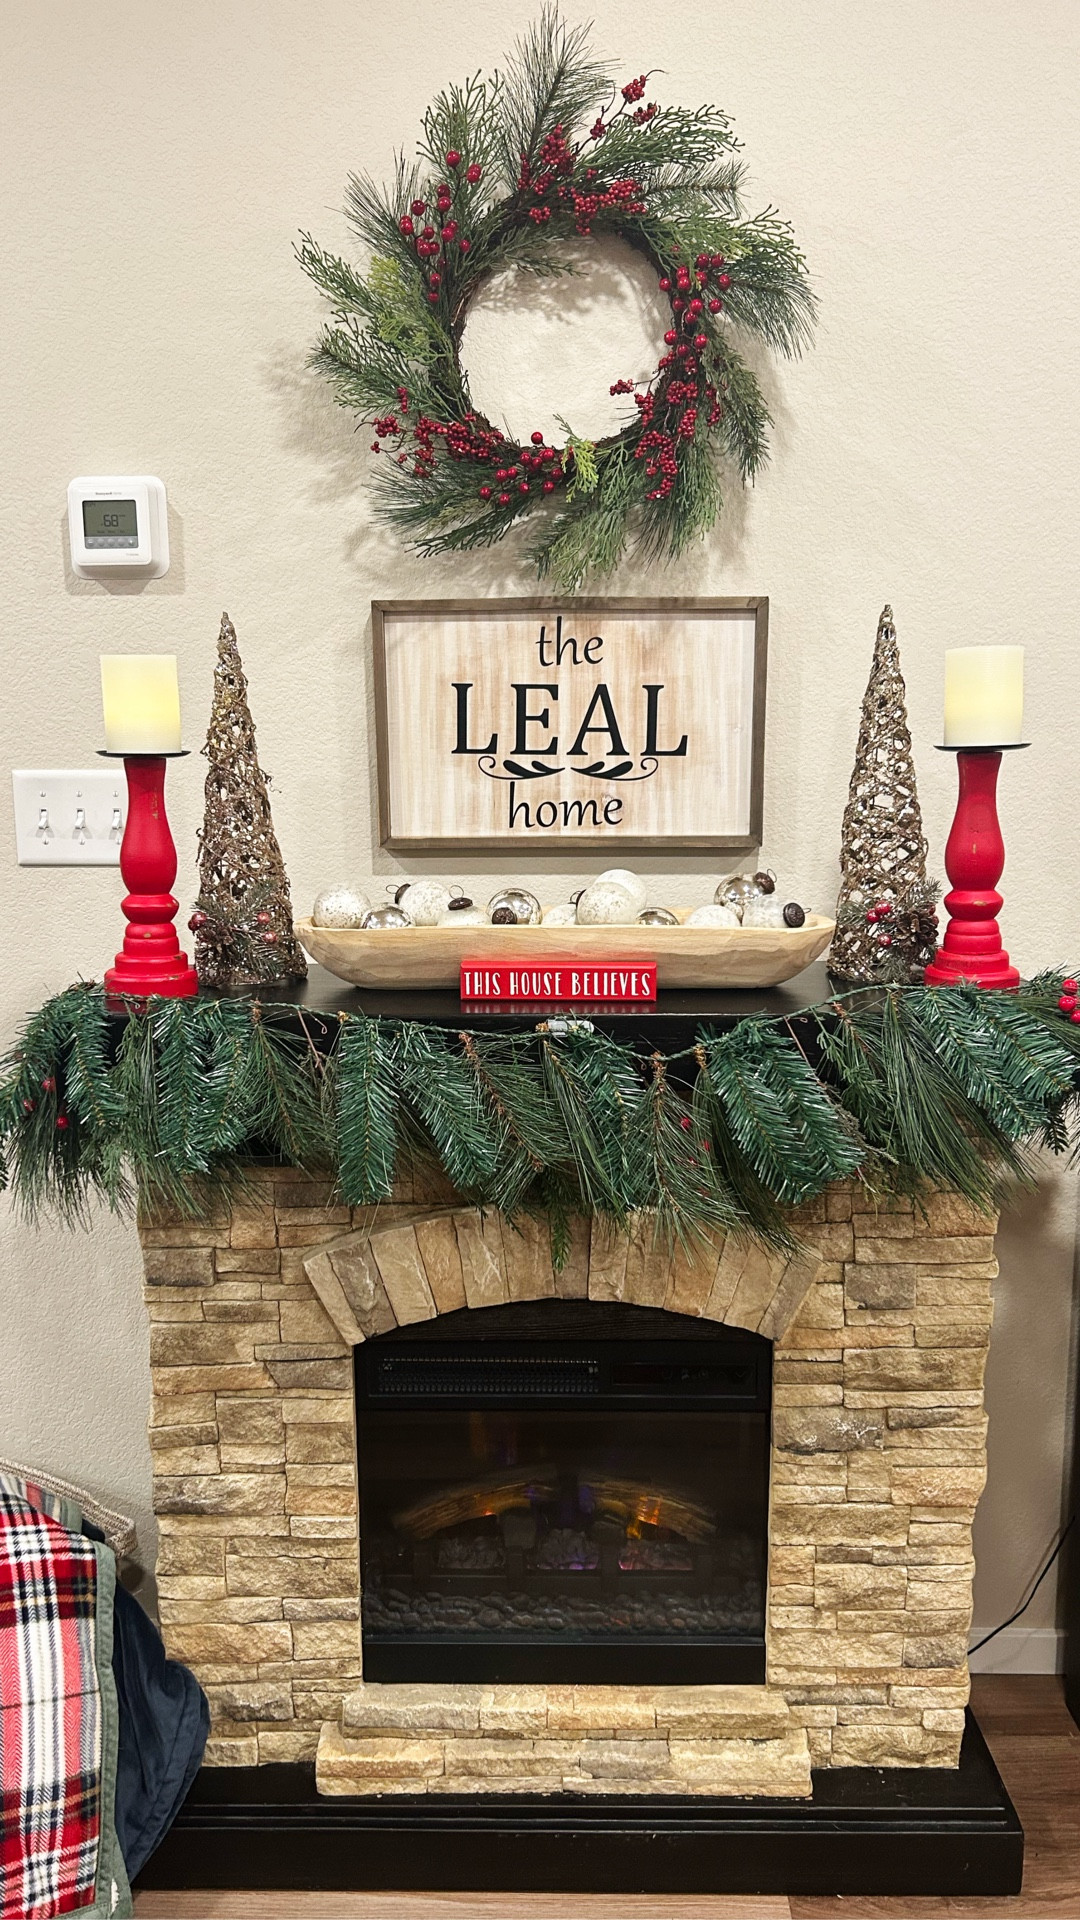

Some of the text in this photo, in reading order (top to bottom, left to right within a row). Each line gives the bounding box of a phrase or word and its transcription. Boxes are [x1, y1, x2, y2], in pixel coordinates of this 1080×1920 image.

[103, 514, 119, 527] 68
[535, 615, 604, 667] the
[450, 682, 689, 757] LEAL
[508, 780, 623, 829] home
[463, 971, 651, 996] THIS HOUSE BELIEVES
